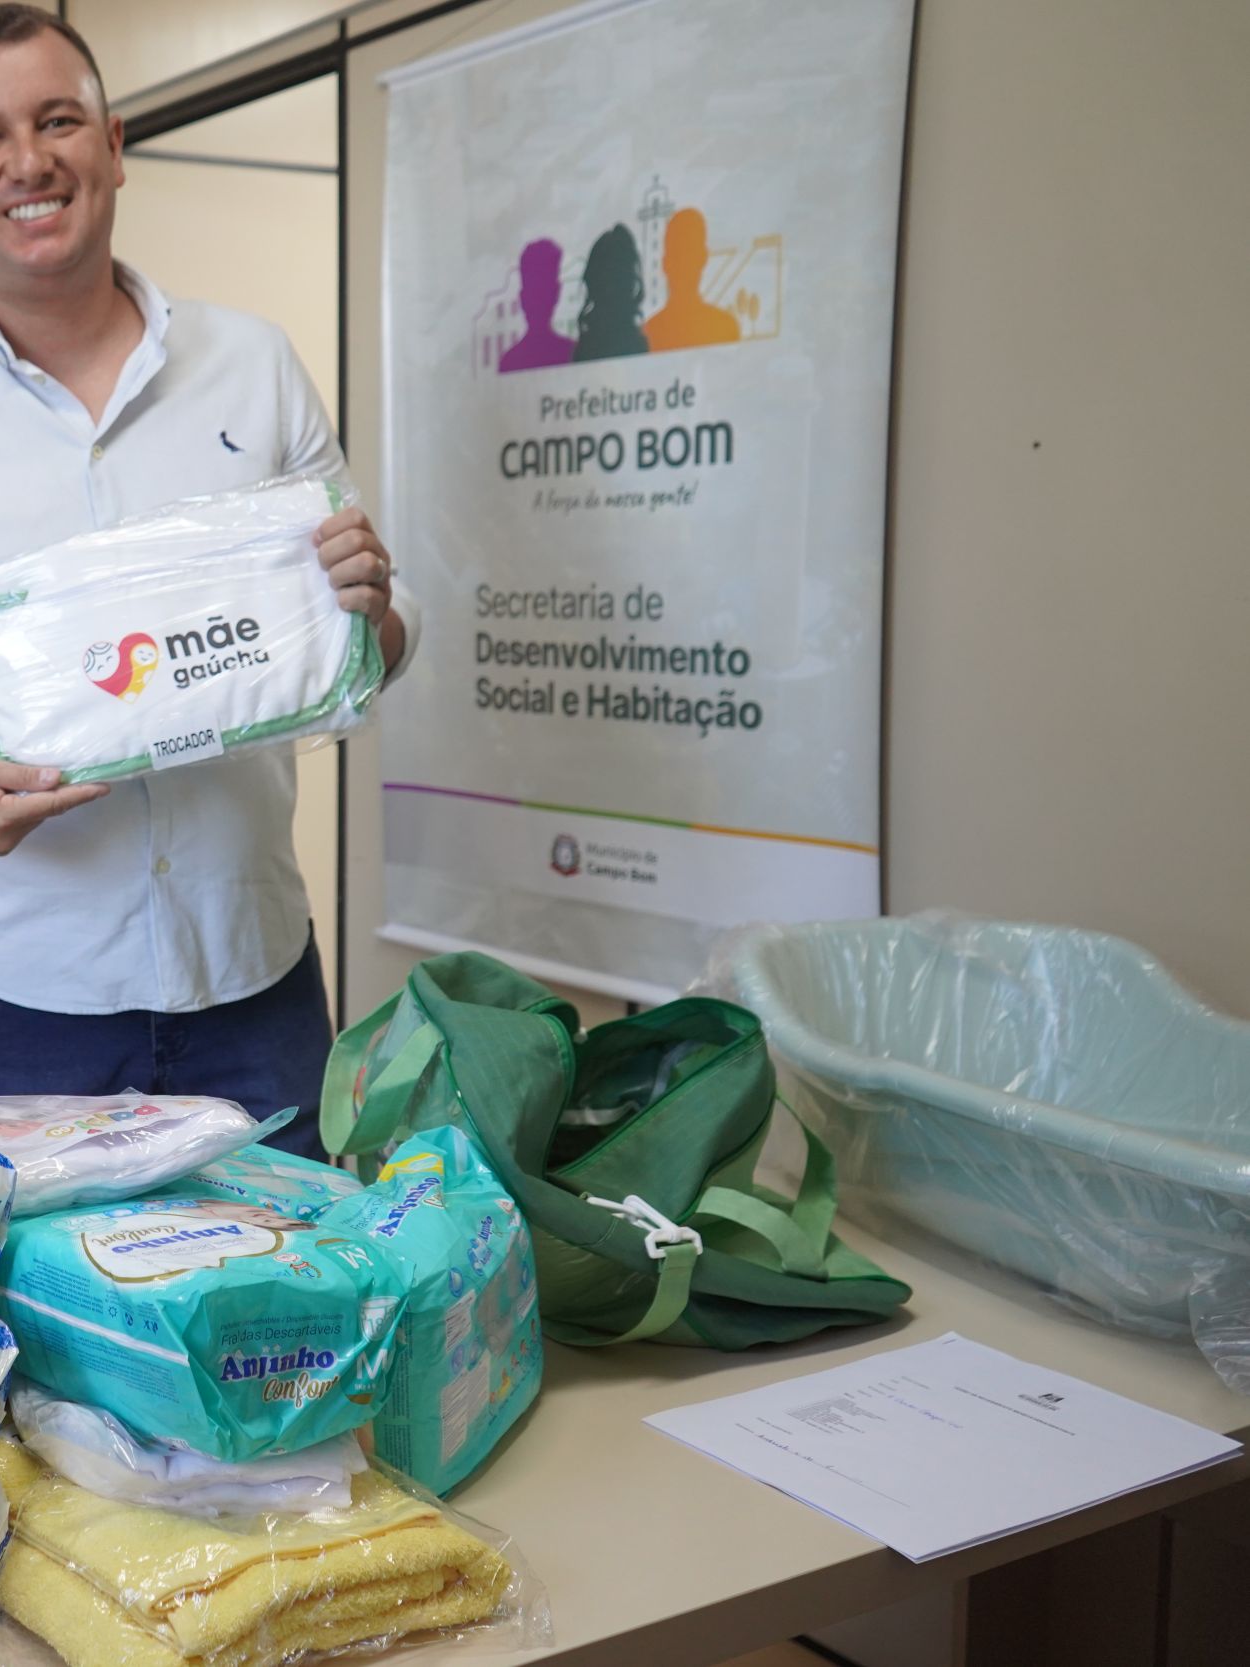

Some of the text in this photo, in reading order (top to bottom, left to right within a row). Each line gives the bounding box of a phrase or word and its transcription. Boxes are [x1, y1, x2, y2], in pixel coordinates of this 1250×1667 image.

[540, 378, 696, 421] Prefeitura de
[500, 421, 734, 479] CAMPO BOM
[475, 583, 664, 621] Secretaria de
[165, 616, 261, 660] mãe
[476, 631, 751, 676] Desenvolvimento
[174, 649, 270, 689] gaúcha
[475, 676, 763, 739] Social e Habitação
[153, 729, 216, 758] TROCADOR
[374, 1177, 442, 1238] Anjinho
[111, 1224, 244, 1254] Anjinho
[265, 1322, 342, 1341] Descartáveis
[220, 1345, 336, 1382] Anjinho
